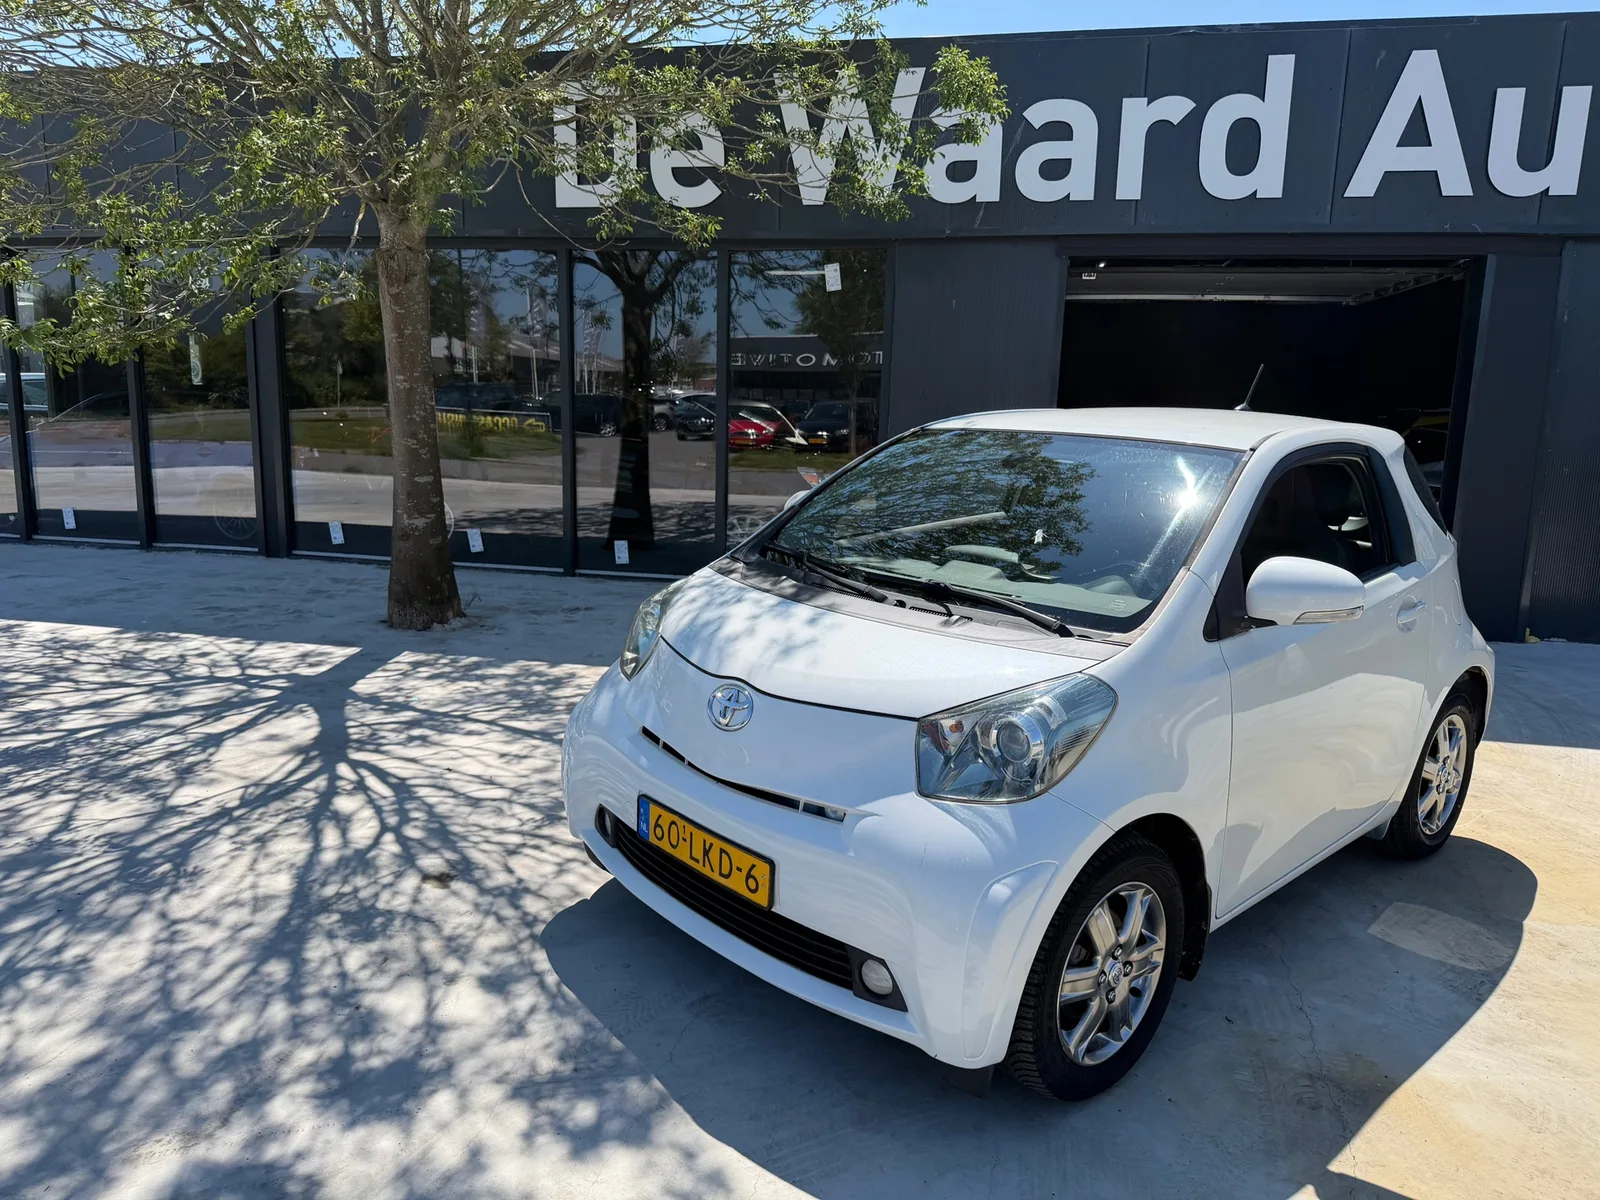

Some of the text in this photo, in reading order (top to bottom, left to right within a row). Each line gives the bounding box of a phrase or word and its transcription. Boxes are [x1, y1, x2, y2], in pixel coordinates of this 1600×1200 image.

[553, 49, 1593, 208] De Waard Au
[640, 813, 760, 895] NL 60-LKD-6
